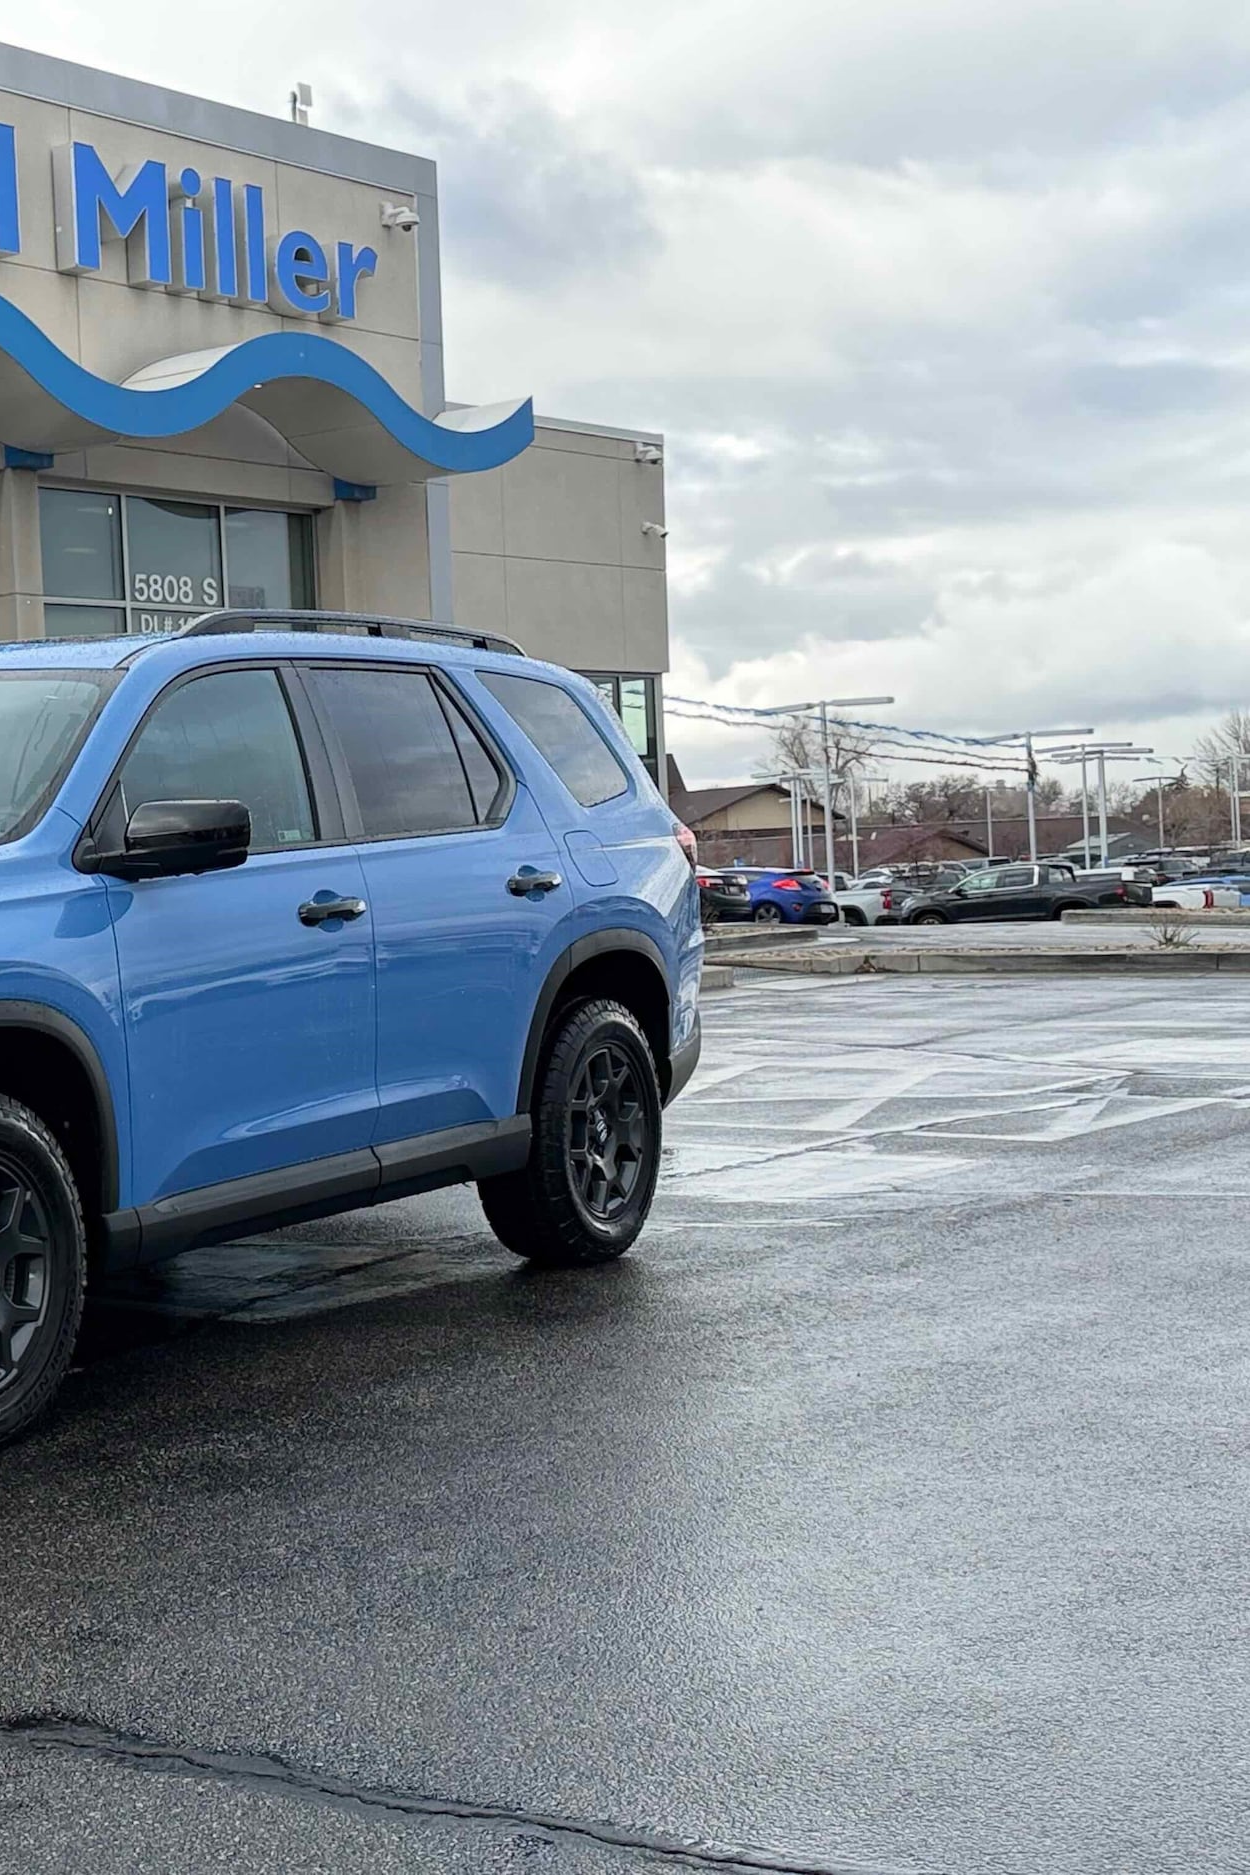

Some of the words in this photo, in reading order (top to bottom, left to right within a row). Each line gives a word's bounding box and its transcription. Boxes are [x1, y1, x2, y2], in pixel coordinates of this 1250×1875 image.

[72, 141, 379, 321] Miller
[134, 573, 193, 603] 5808
[202, 577, 218, 606] S
